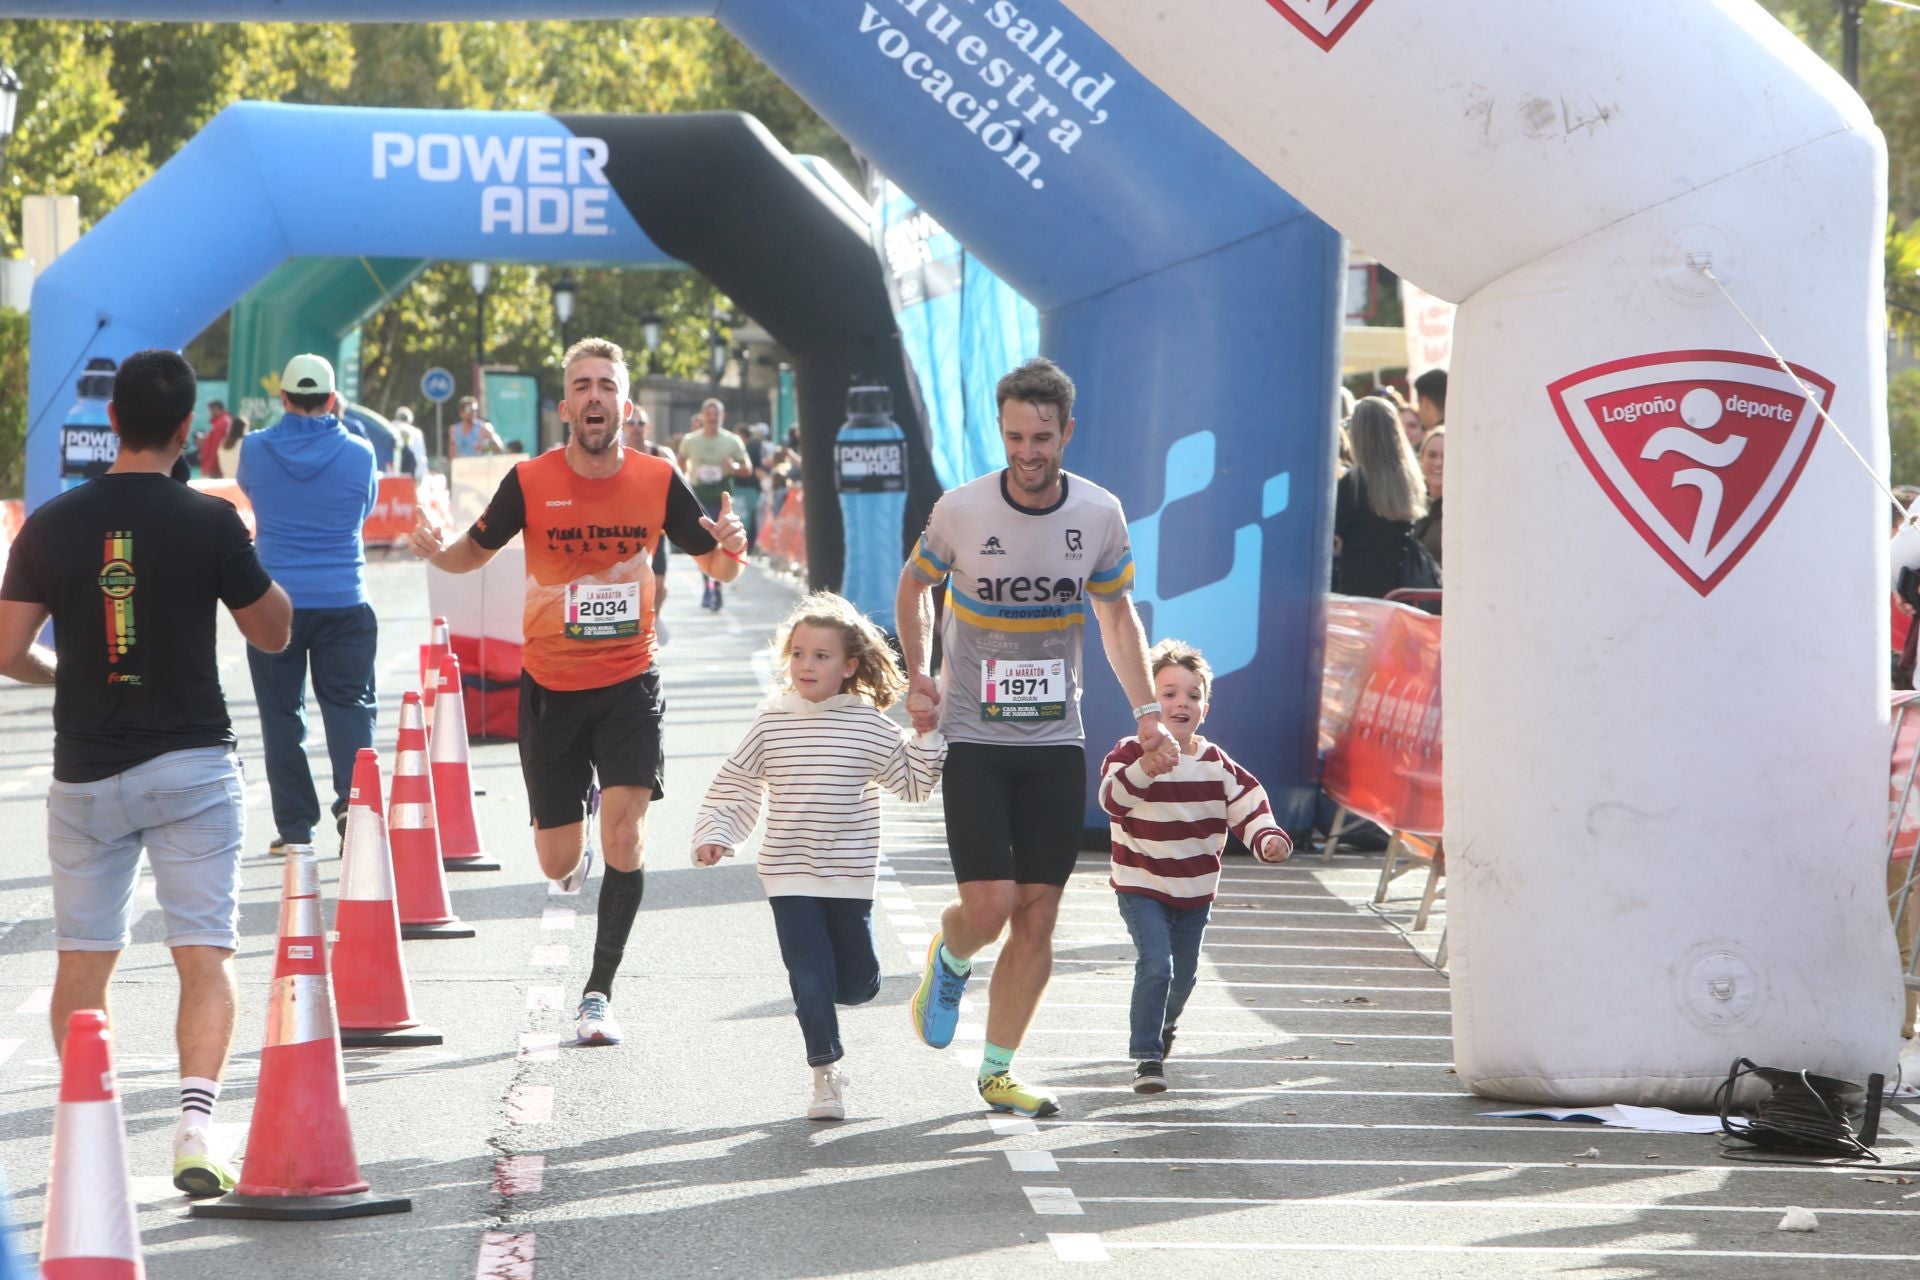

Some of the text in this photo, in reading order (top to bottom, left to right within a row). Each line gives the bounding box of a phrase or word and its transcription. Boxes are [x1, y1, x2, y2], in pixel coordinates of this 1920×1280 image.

[984, 0, 1117, 124] salud,
[858, 2, 1044, 189] vocación.
[372, 132, 609, 184] POWER
[481, 185, 609, 235] ADE
[1602, 395, 1793, 423] Logroño deporte
[66, 431, 120, 447] POWE
[841, 446, 901, 461] POWER
[977, 576, 1083, 602] aresol
[580, 600, 628, 616] 2034
[1005, 668, 1014, 677] LA
[1015, 666, 1044, 677] MARATÓN
[1000, 679, 1048, 695] 1971
